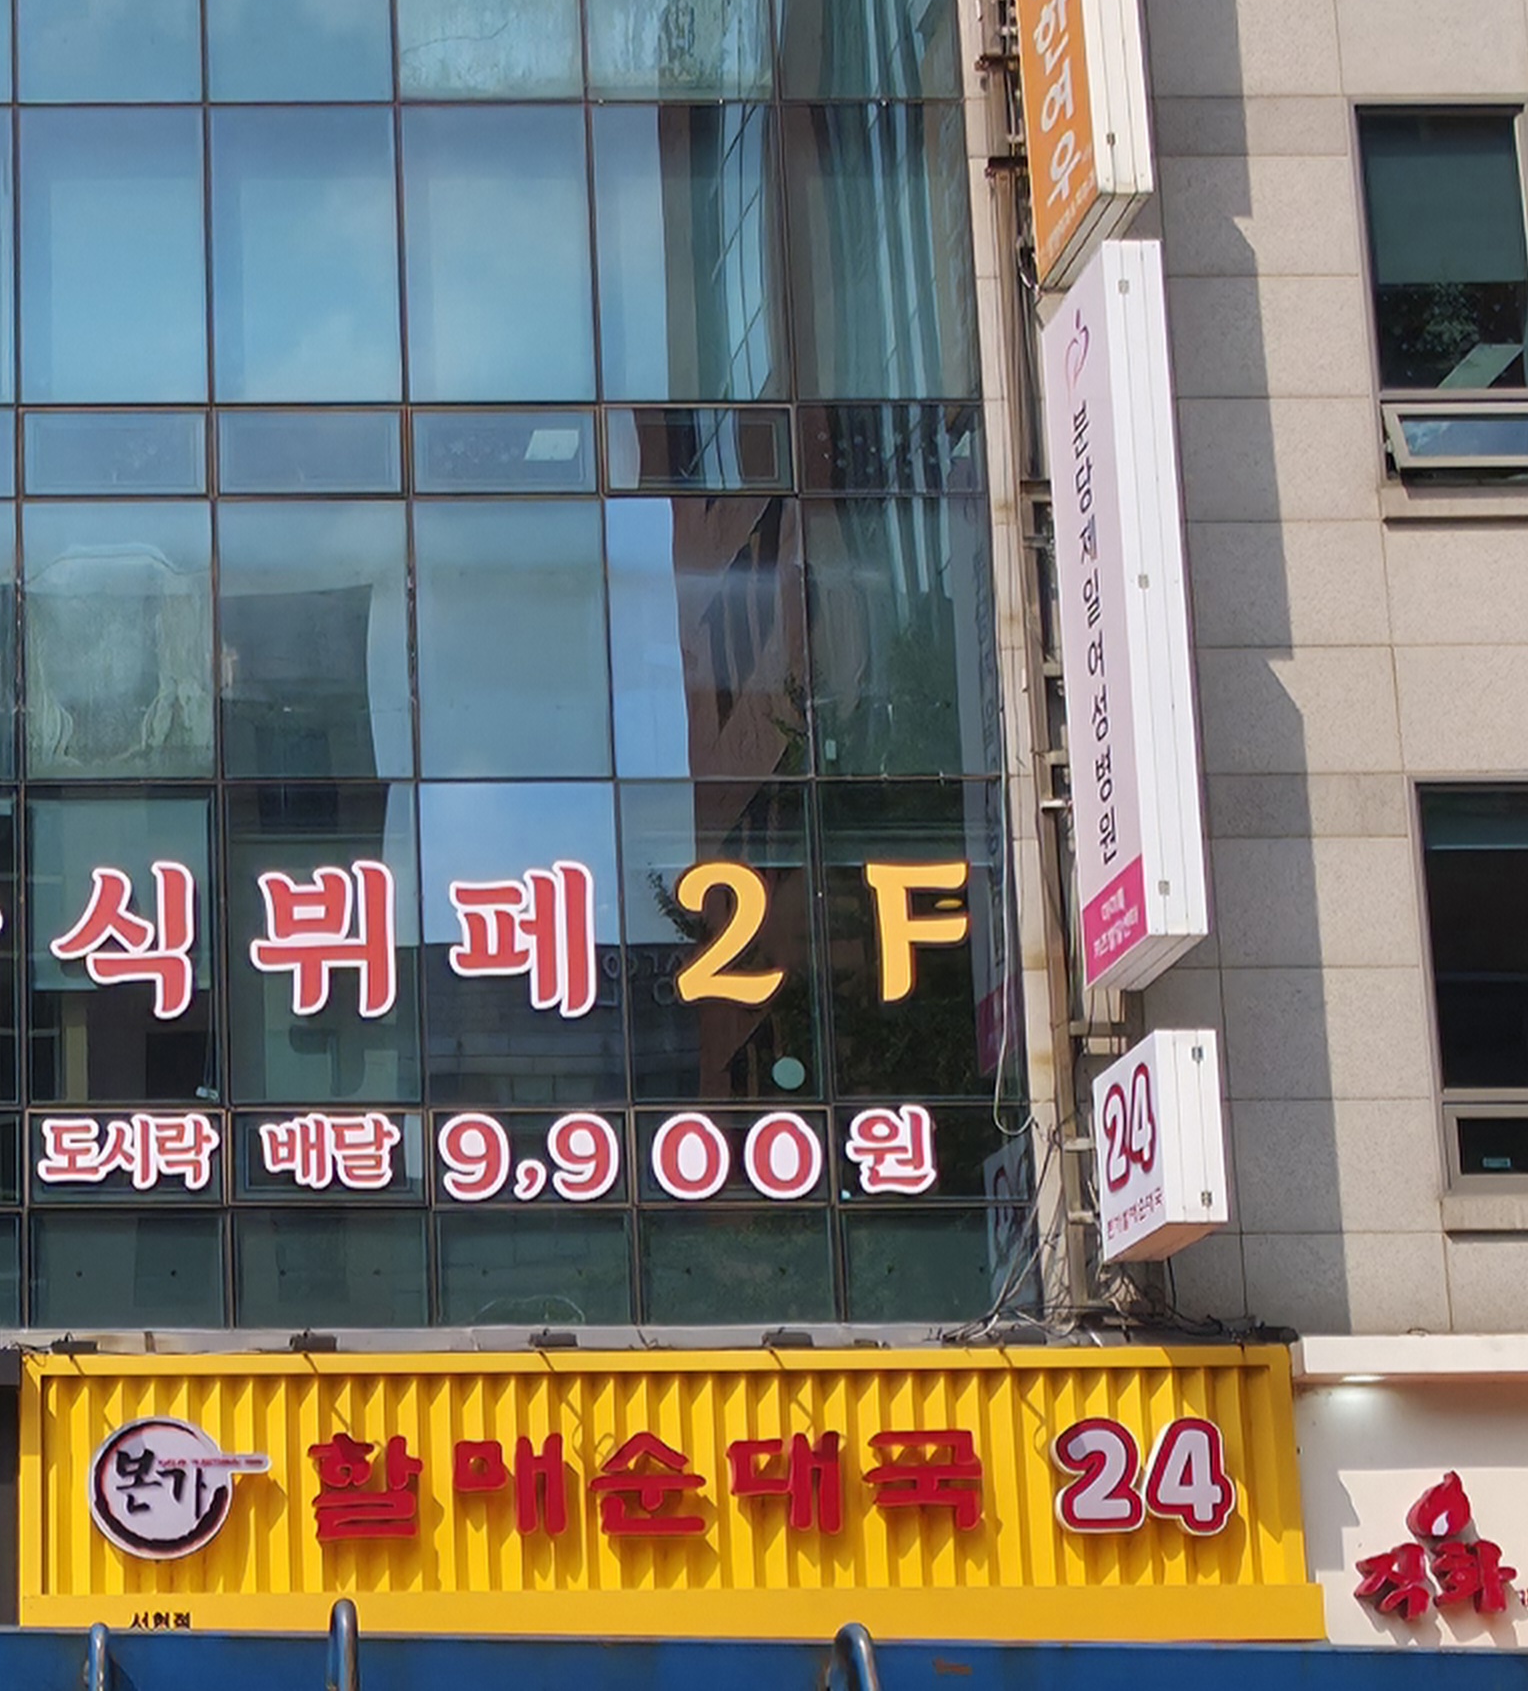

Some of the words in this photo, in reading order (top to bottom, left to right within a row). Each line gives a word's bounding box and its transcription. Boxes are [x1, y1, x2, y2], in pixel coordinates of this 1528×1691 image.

[1072, 399, 1118, 866] 분당제일여성병원
[673, 860, 971, 1006] 2F
[35, 1112, 221, 1191] 도시락
[259, 1112, 401, 1190] 배달
[1102, 1061, 1158, 1194] 24
[115, 1447, 208, 1520] 본가
[306, 1429, 986, 1543] 할매순대국
[1050, 1415, 1237, 1537] 24
